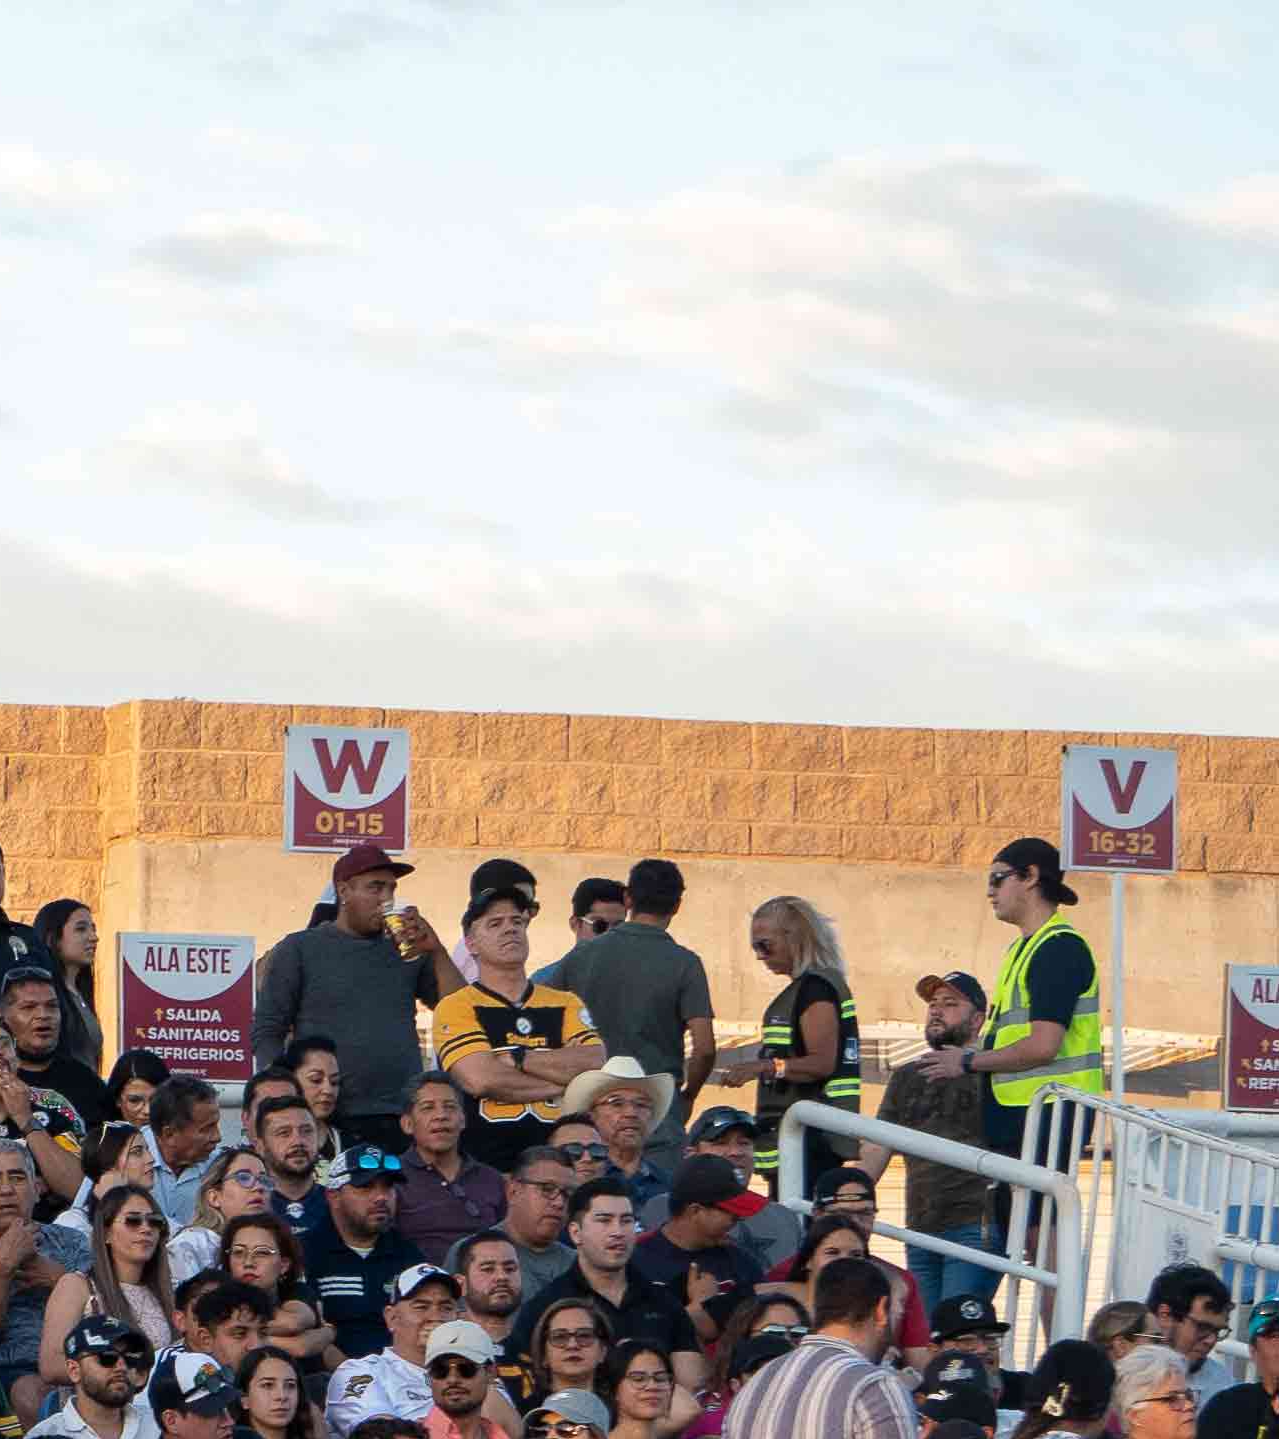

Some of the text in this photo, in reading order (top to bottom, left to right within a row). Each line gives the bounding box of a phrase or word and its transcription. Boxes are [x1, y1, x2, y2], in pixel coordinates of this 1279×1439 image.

[312, 737, 389, 794] W
[1099, 759, 1148, 814] V
[314, 811, 385, 834] 01-15
[1088, 831, 1156, 855] 16-32
[144, 945, 232, 974] ALA ESTE
[165, 1007, 222, 1023] SALIDA
[147, 1027, 241, 1042] SANITARIOS
